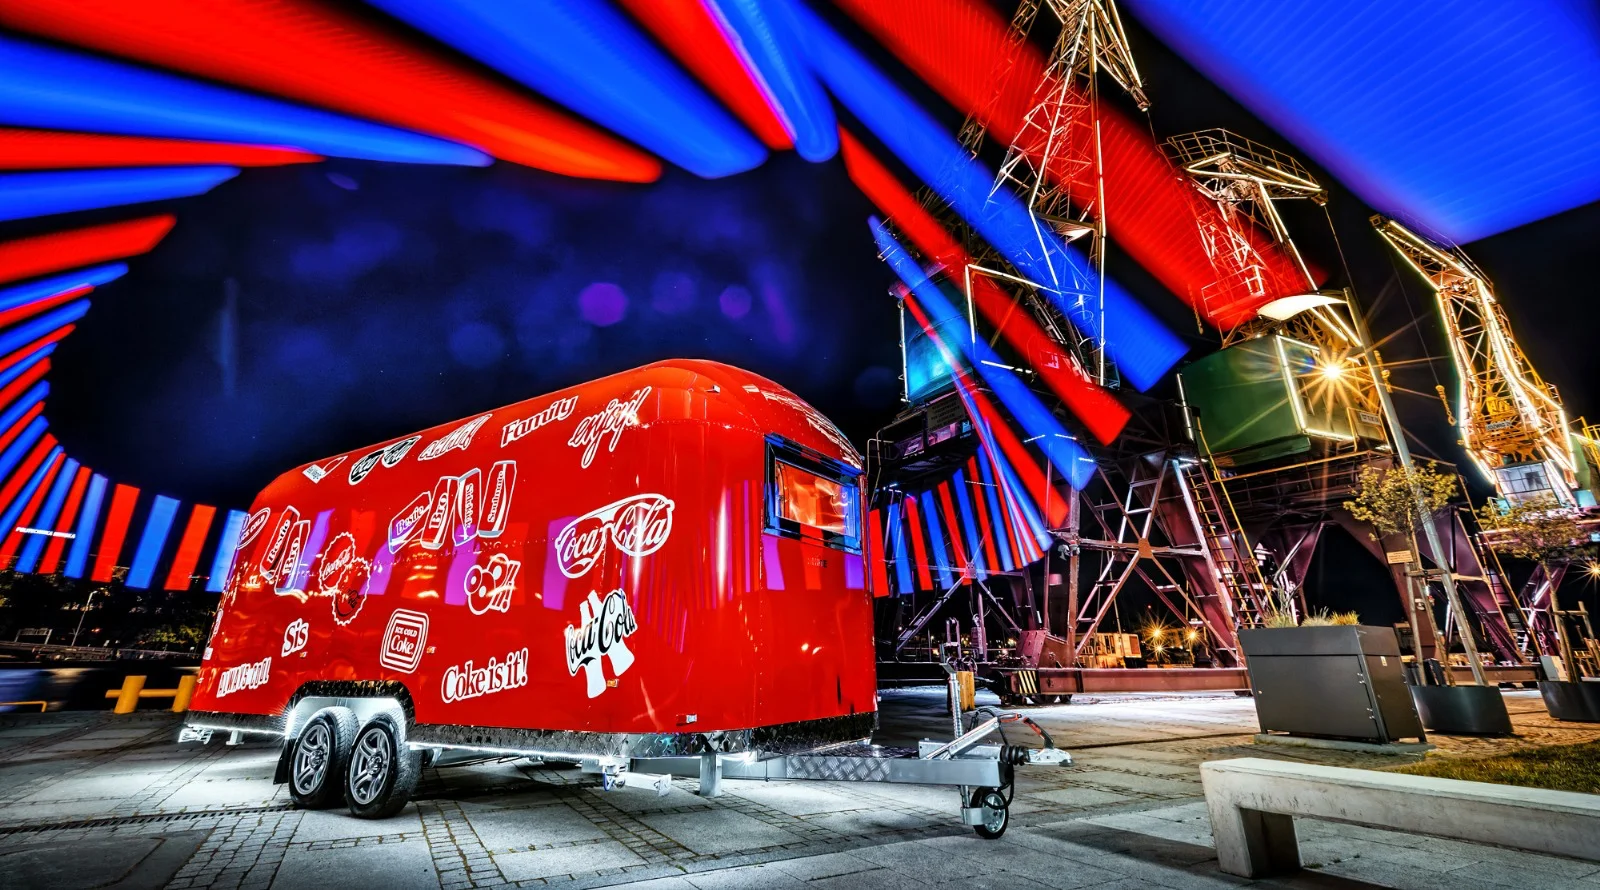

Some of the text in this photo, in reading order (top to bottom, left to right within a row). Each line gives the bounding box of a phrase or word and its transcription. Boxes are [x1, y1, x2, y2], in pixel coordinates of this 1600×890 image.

[502, 397, 577, 446] Family
[429, 493, 448, 528] Bro
[487, 471, 504, 523] Soulmate
[396, 506, 424, 535] Bestie
[267, 519, 290, 563] Bestie
[282, 537, 300, 575] Bro
[282, 620, 308, 656] Sis
[391, 634, 414, 655] Coke
[394, 626, 418, 637] ICE COLD
[218, 657, 272, 697] ALWAYS COOL
[442, 649, 528, 701] Coke is it!
